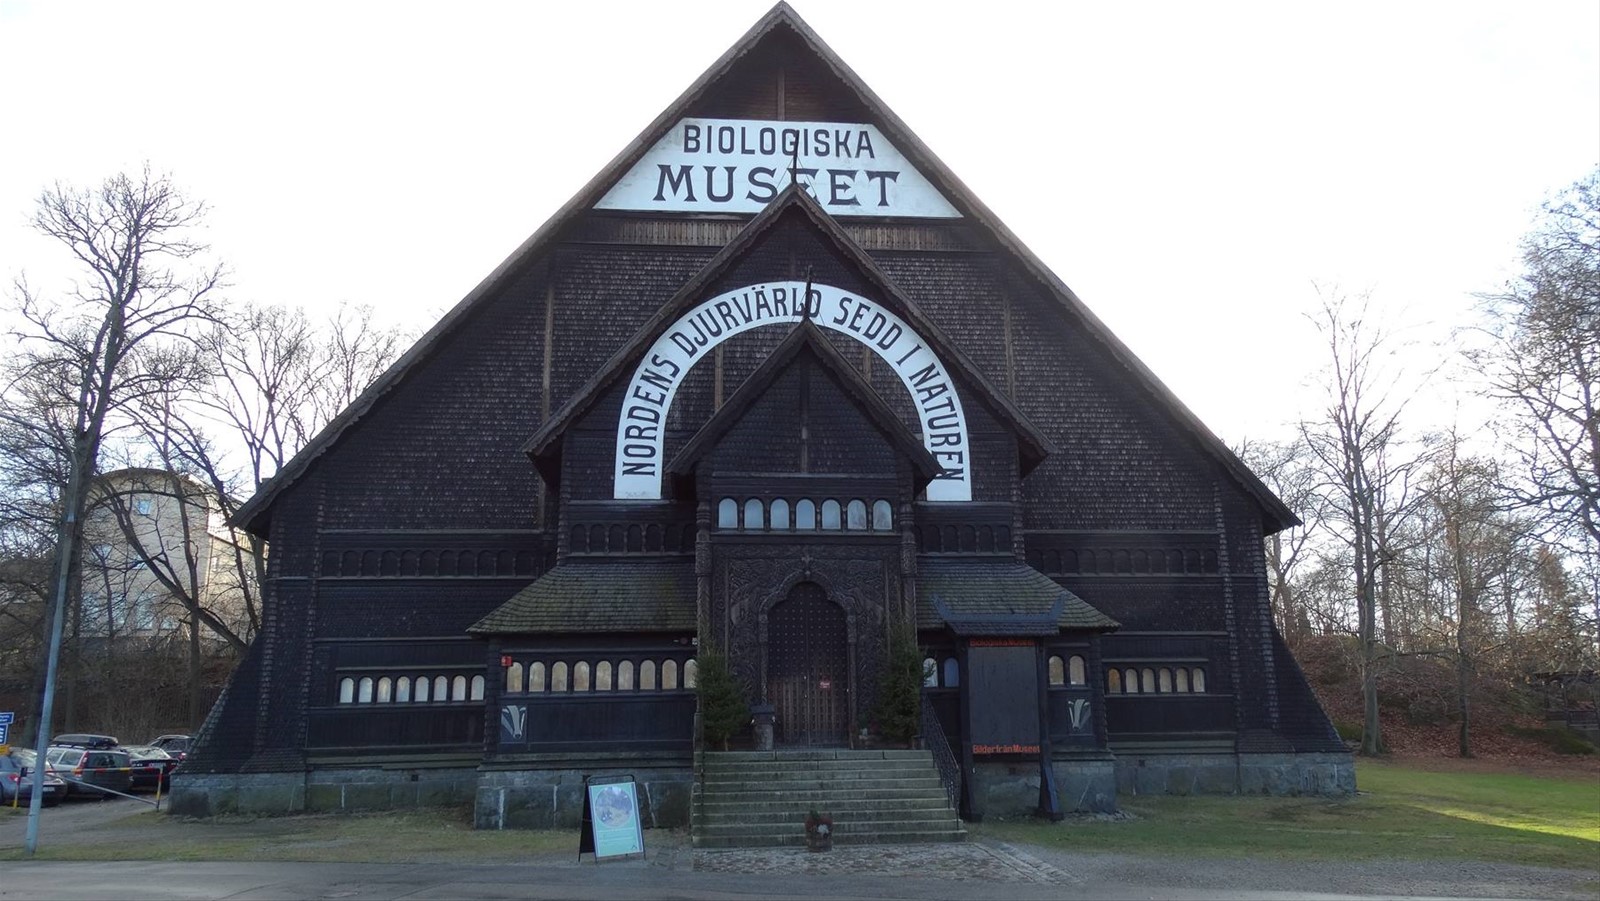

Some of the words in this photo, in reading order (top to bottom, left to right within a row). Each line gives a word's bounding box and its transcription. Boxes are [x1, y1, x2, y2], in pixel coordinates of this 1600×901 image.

[683, 125, 875, 159] BIOLOGISKA
[652, 164, 900, 207] MUSEET
[669, 285, 823, 359] DJURVÄRLD
[833, 296, 903, 351] SEDD
[896, 343, 923, 367] I
[622, 354, 681, 477] NORDENS
[908, 362, 965, 482] NATUREN
